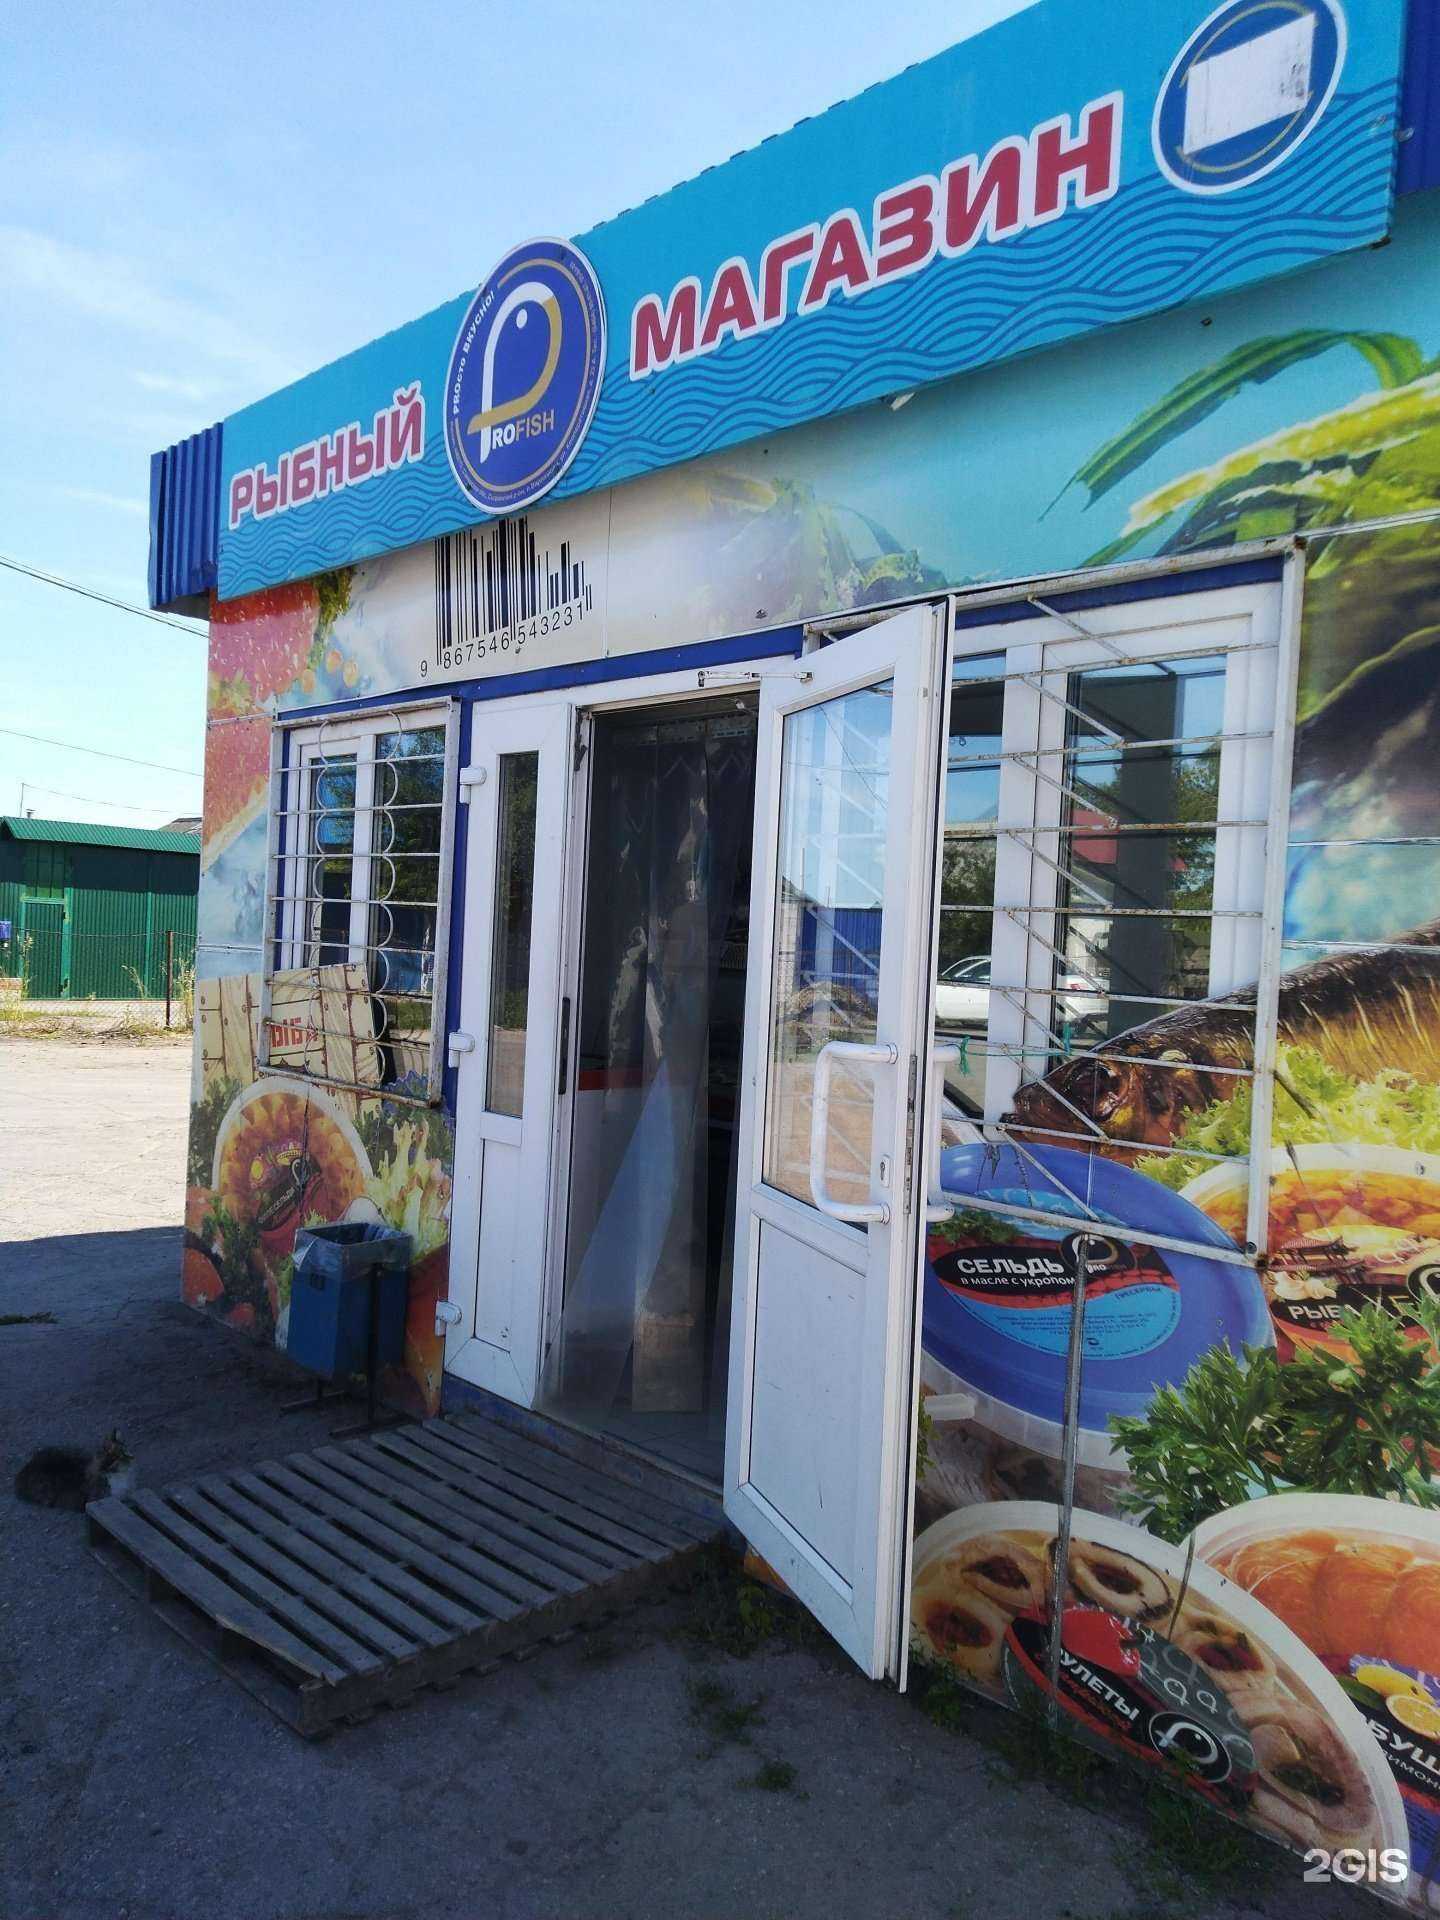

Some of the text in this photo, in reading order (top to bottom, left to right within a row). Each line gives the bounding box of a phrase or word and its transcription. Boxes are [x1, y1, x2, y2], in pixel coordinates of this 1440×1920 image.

[228, 380, 426, 530] РЫБНЫЙ
[628, 91, 1124, 381] МАГАЗИН
[420, 660, 428, 678] 9
[957, 1257, 1065, 1277] СЕЛЬДЬ
[971, 1276, 1009, 1287] масле
[1021, 1276, 1076, 1289] укропом
[1058, 1645, 1140, 1721] УЛЕТЫ
